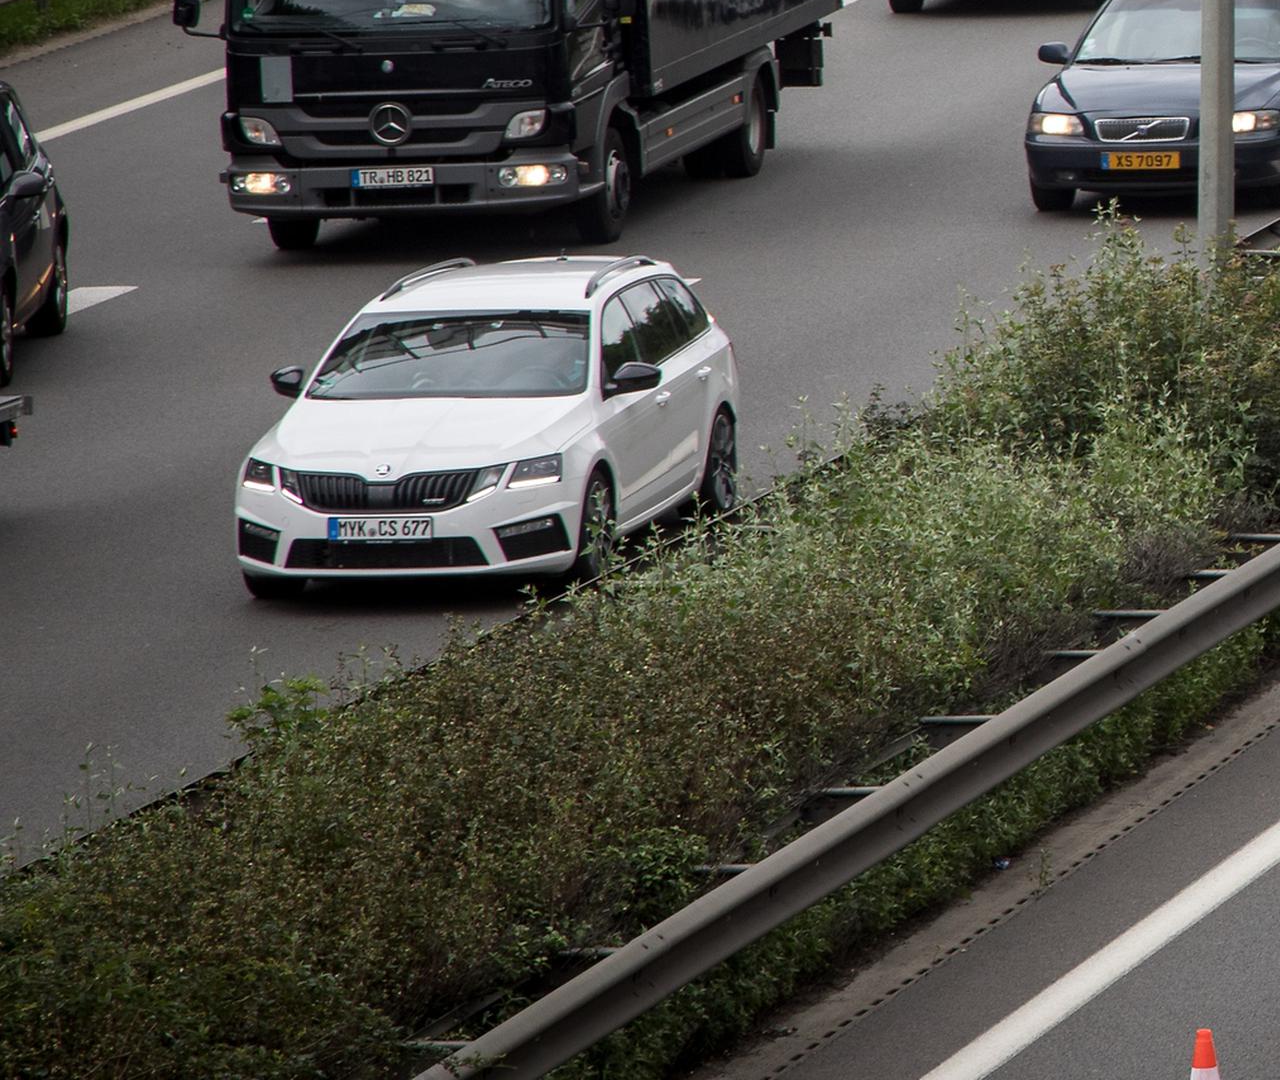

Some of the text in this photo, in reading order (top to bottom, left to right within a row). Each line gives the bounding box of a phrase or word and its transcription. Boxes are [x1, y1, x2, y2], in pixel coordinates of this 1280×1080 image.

[1116, 155, 1172, 167] XS 7097
[361, 169, 431, 184] TR HB 821
[338, 520, 430, 537] MYK CS 677
